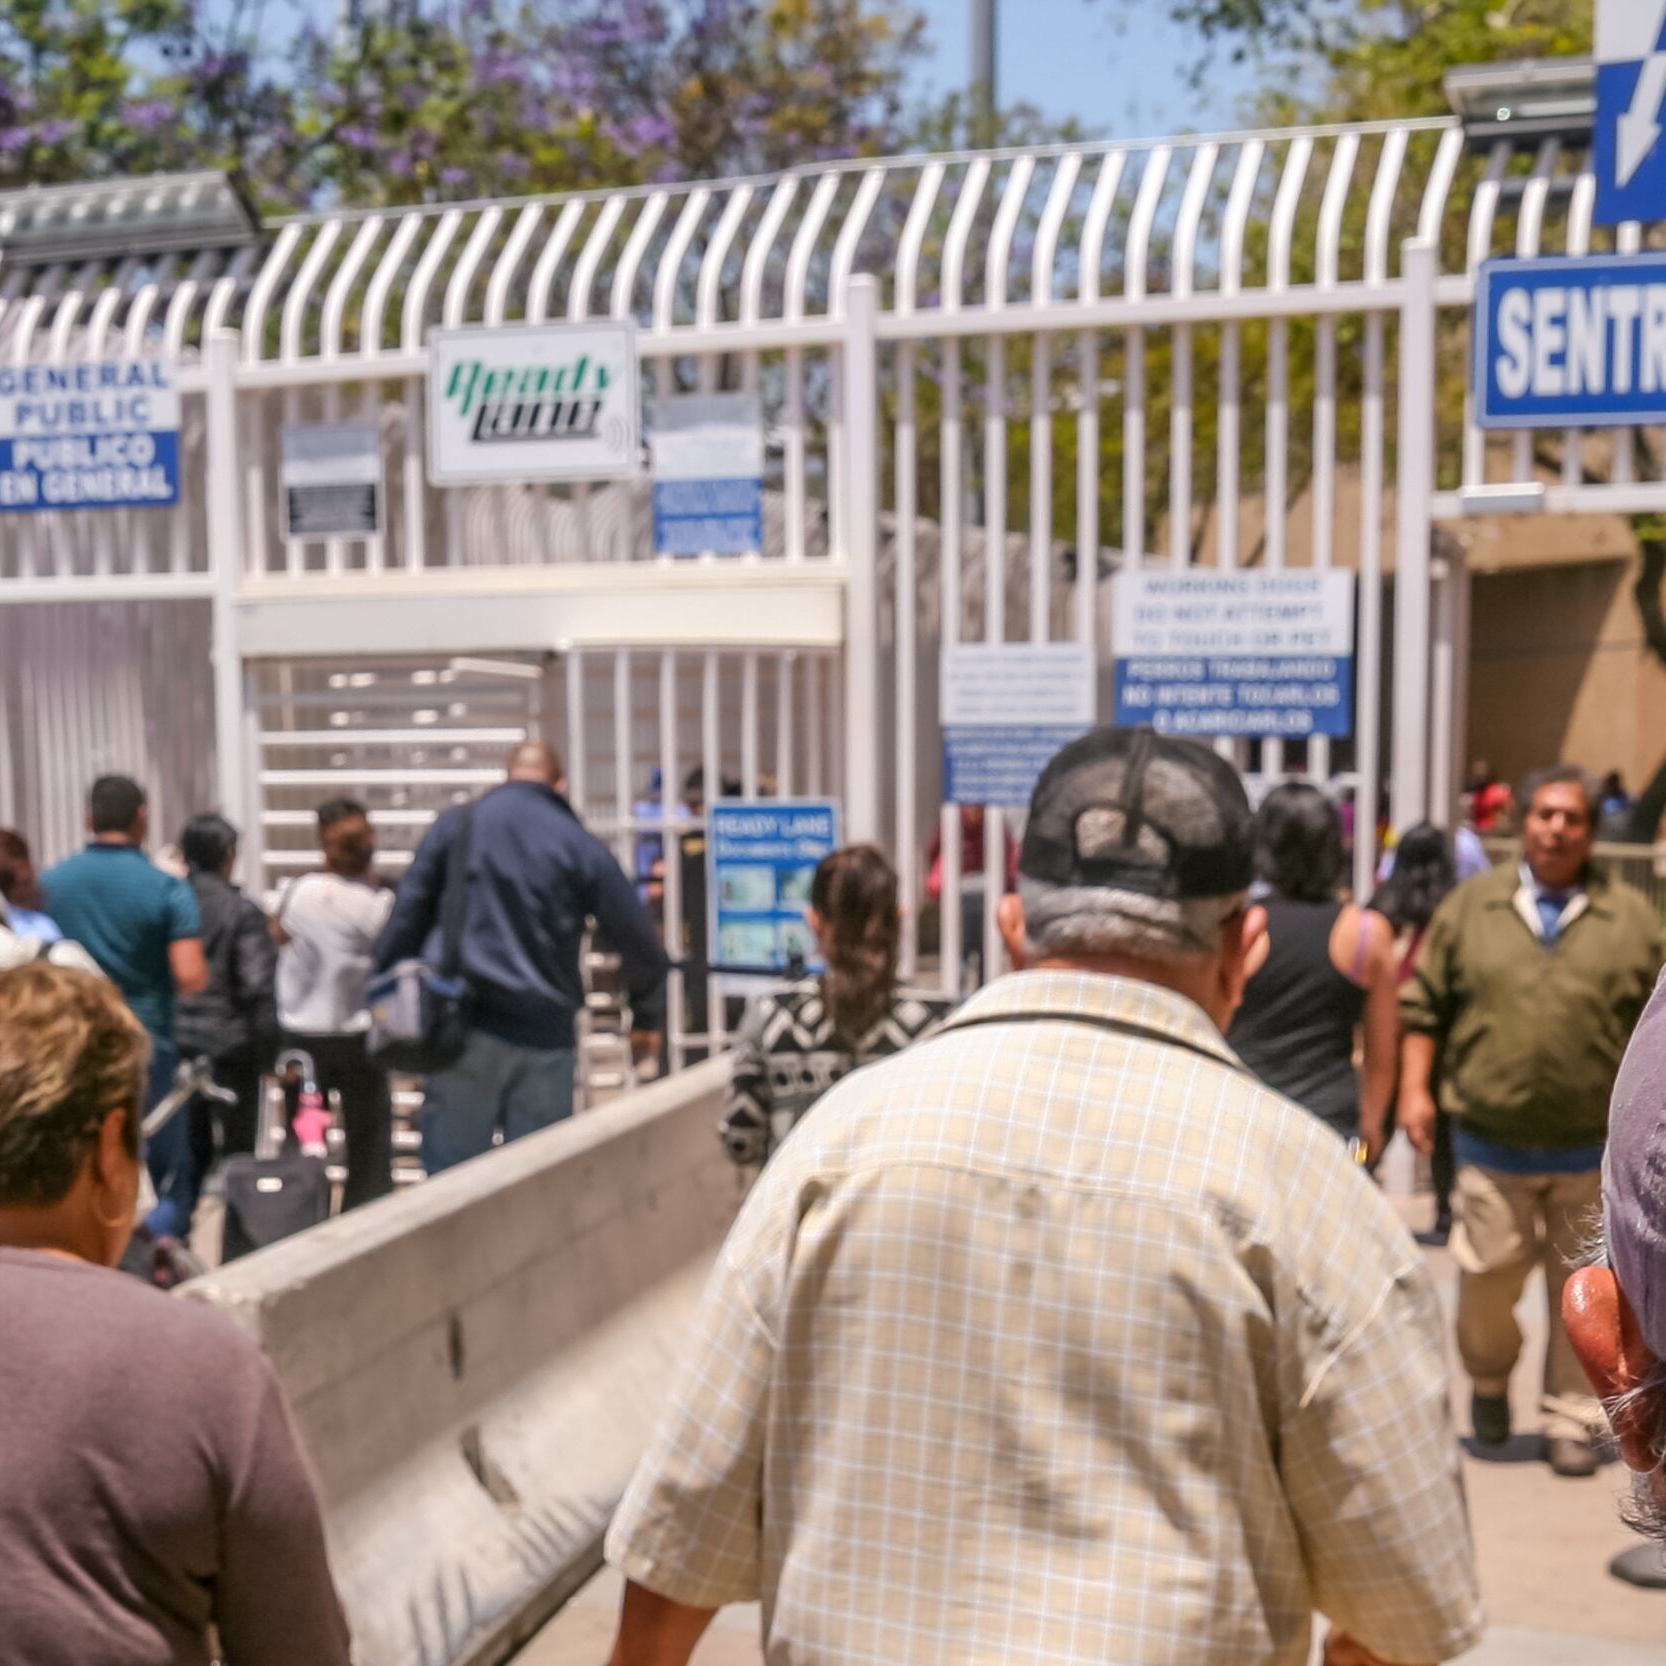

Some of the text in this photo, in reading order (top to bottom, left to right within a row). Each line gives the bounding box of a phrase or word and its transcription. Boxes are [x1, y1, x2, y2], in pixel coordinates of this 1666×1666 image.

[15, 395, 150, 426] PUBLIC
[41, 464, 174, 502] GENERAL
[1144, 578, 1246, 595] WORKING
[1122, 684, 1152, 707] NO
